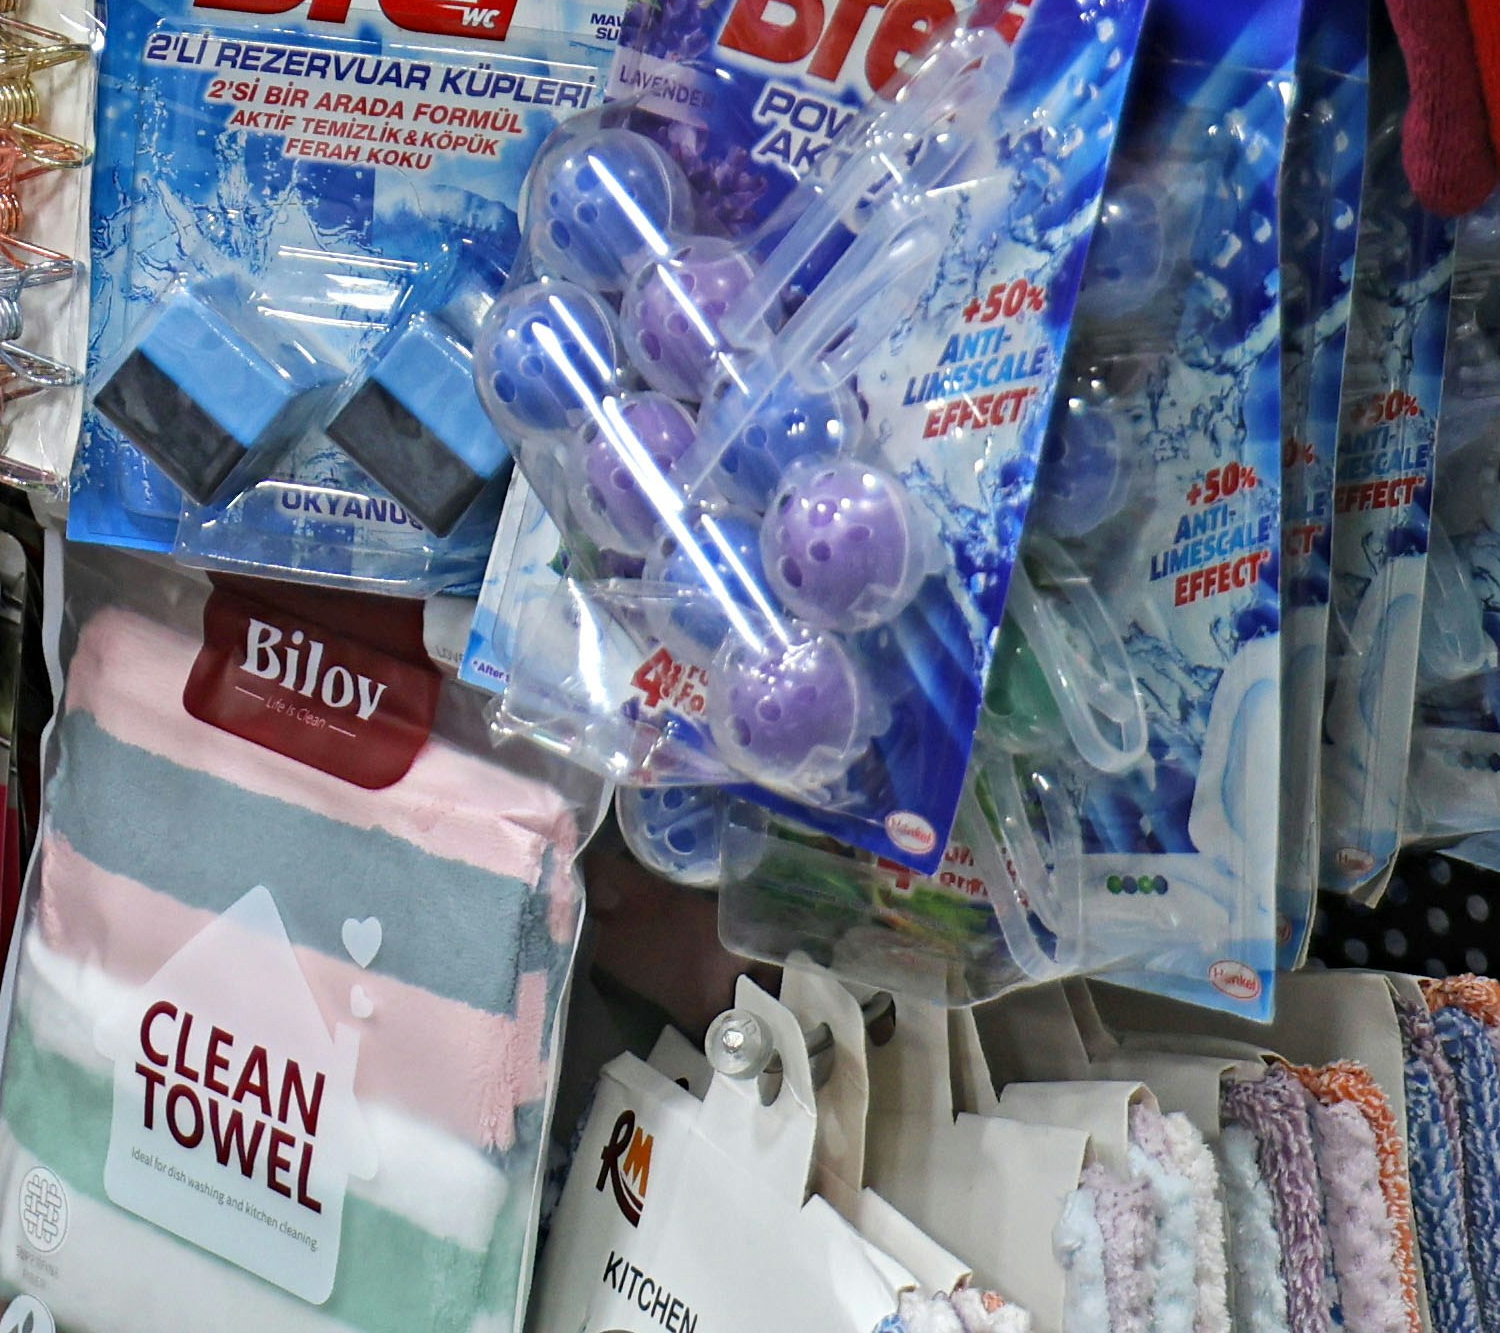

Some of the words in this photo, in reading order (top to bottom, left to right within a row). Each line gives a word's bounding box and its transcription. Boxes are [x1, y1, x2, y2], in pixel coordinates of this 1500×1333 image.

[460, 7, 501, 30] WC
[214, 42, 429, 93] REZERVUAR
[437, 63, 596, 110] KÜPLERİ
[228, 108, 295, 132] AKTİF
[263, 84, 310, 108] BİR
[314, 93, 405, 120] ARADA
[411, 99, 523, 136] FORMÜL
[284, 137, 361, 162] FERAH
[365, 145, 433, 170] KOKU
[961, 280, 1044, 325] +50%
[937, 326, 1016, 364] ANTI-
[902, 353, 1046, 406] LIMESCALE
[1186, 461, 1257, 506] +50%
[1149, 511, 1271, 581] LIMESCALE
[1173, 505, 1237, 543] ANTI-
[265, 694, 285, 714] Life
[296, 706, 327, 730] Clean
[138, 1000, 327, 1137] CLEAN
[135, 1062, 323, 1215] TOWEL
[131, 1145, 153, 1169] Ideal
[153, 1156, 167, 1175] for
[167, 1162, 187, 1185] dish
[187, 1172, 226, 1207] washing
[226, 1189, 243, 1211] and
[243, 1199, 279, 1231] kitchen
[602, 1249, 699, 1333] KITCHEN
